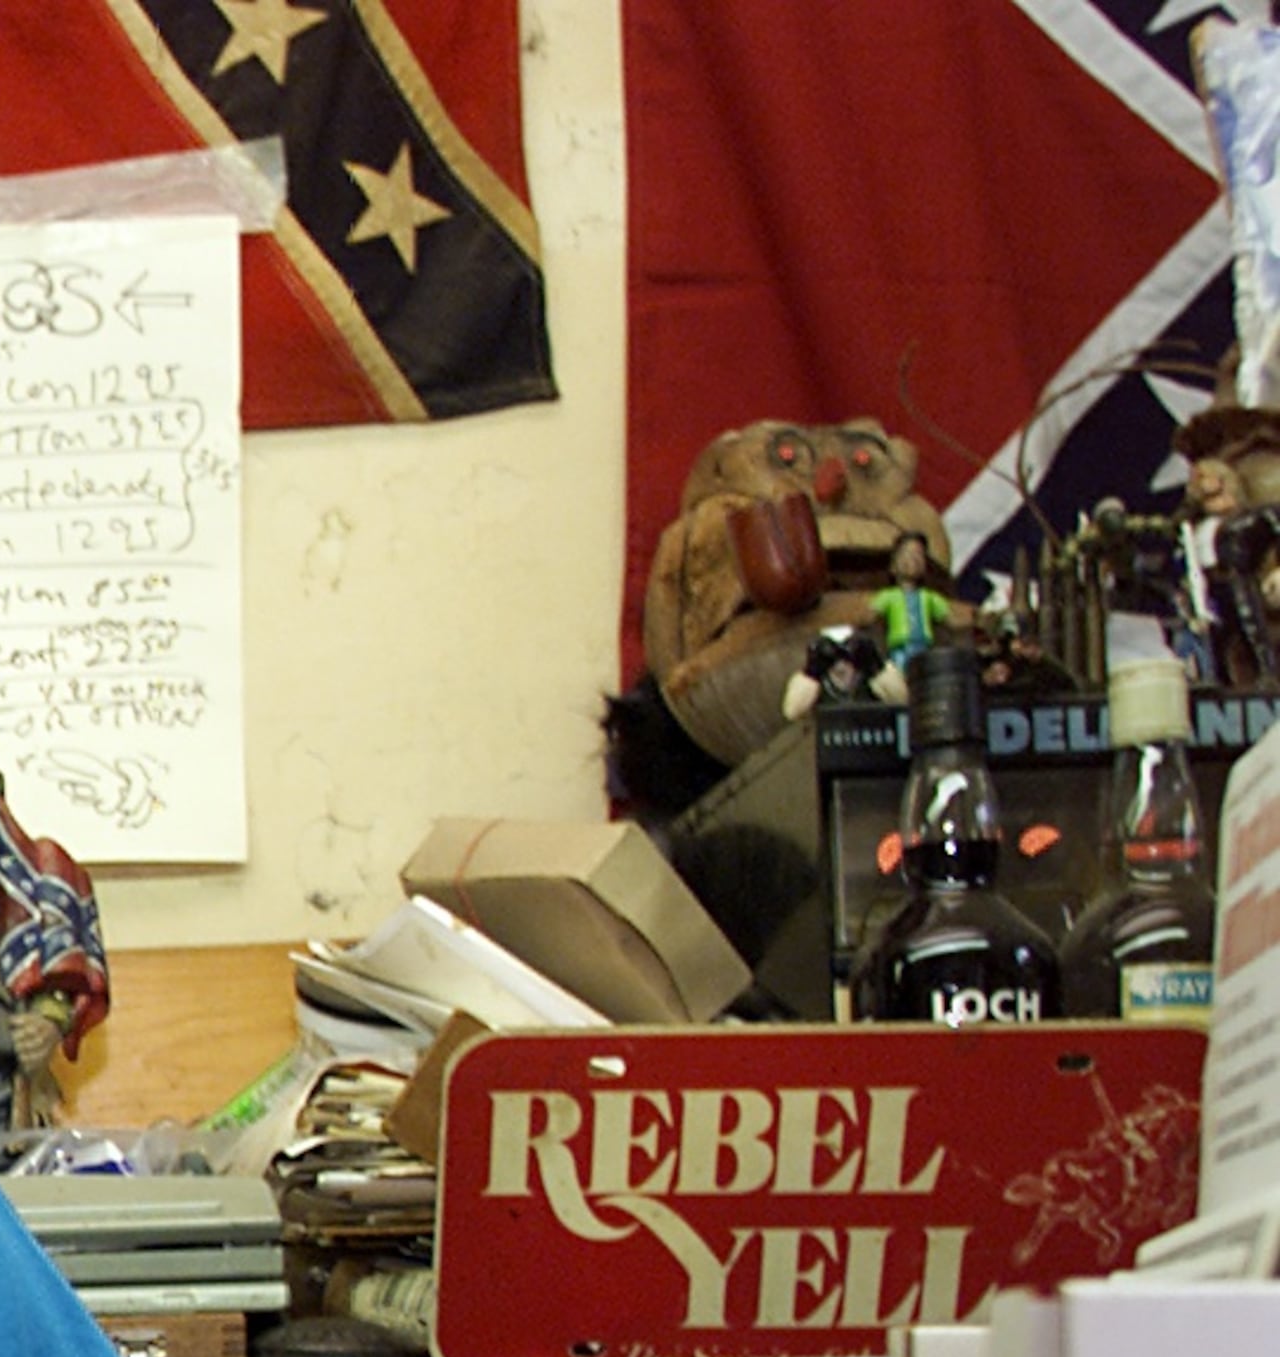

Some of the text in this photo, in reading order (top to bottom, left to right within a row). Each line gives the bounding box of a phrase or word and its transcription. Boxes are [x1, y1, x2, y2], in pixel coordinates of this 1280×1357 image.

[931, 990, 1040, 1022] LOCH
[481, 1086, 946, 1241] REBEL
[595, 1195, 997, 1329] YELL
